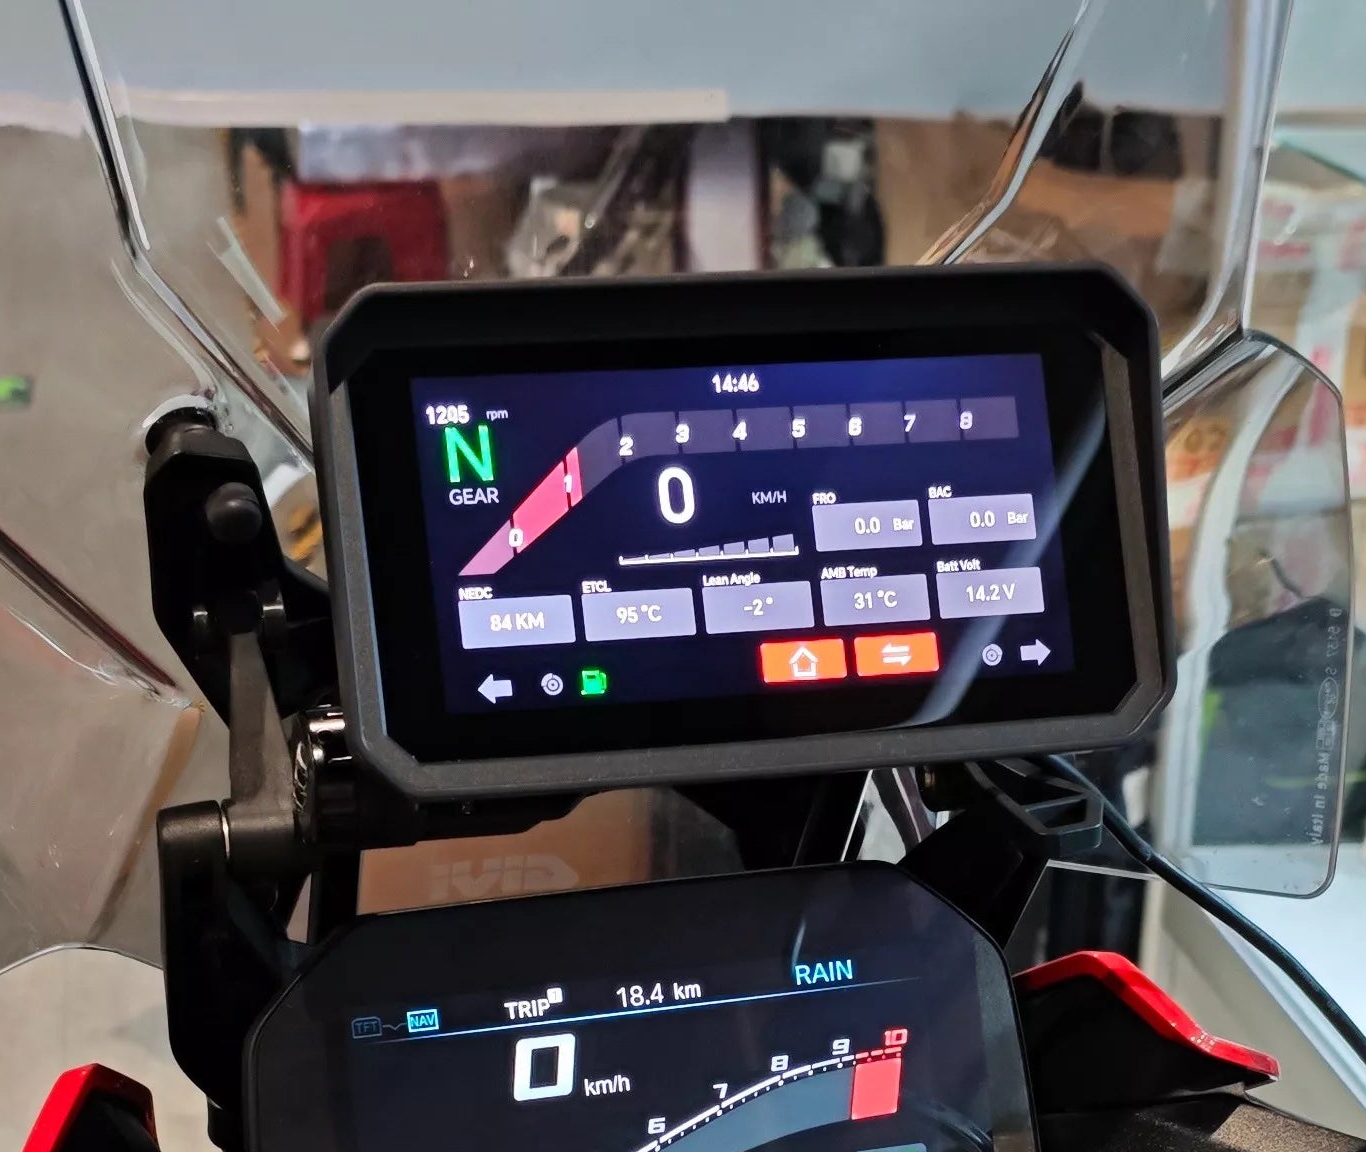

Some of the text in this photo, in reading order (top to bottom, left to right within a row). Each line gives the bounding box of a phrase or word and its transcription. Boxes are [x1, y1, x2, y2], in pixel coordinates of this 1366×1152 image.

[712, 373, 759, 393] 14:46
[486, 409, 508, 421] rpm
[445, 425, 494, 483] N
[509, 412, 973, 547] 0 1 2 3 4 5 6 7 8
[449, 487, 499, 505] GEAR
[657, 467, 695, 524] 0
[752, 491, 787, 504] KM/H
[813, 492, 836, 504] FRO
[929, 486, 952, 498] BAC
[854, 517, 914, 535] 0.0 Bar
[969, 511, 1028, 528] 0.0 Bar
[821, 566, 878, 580] AMB Temp
[937, 559, 981, 573] Batt Volt
[582, 580, 612, 593] ETCL
[702, 572, 761, 587] Lean Angle
[459, 587, 492, 600] NEDC
[854, 592, 872, 610] 31
[966, 583, 1016, 603] 14.2 V
[490, 612, 545, 632] 84 KM
[617, 606, 638, 625] 95
[794, 959, 854, 985] RAIN
[616, 982, 701, 1008] 18.4 km
[504, 999, 551, 1020] TRIP
[355, 1014, 435, 1034] TFT NAV
[513, 1033, 631, 1101] 0 km/h
[648, 1117, 666, 1134] 6
[713, 1083, 728, 1099] 7
[771, 1054, 789, 1071] 8
[832, 1038, 850, 1055] 9
[884, 1028, 908, 1046] 10
